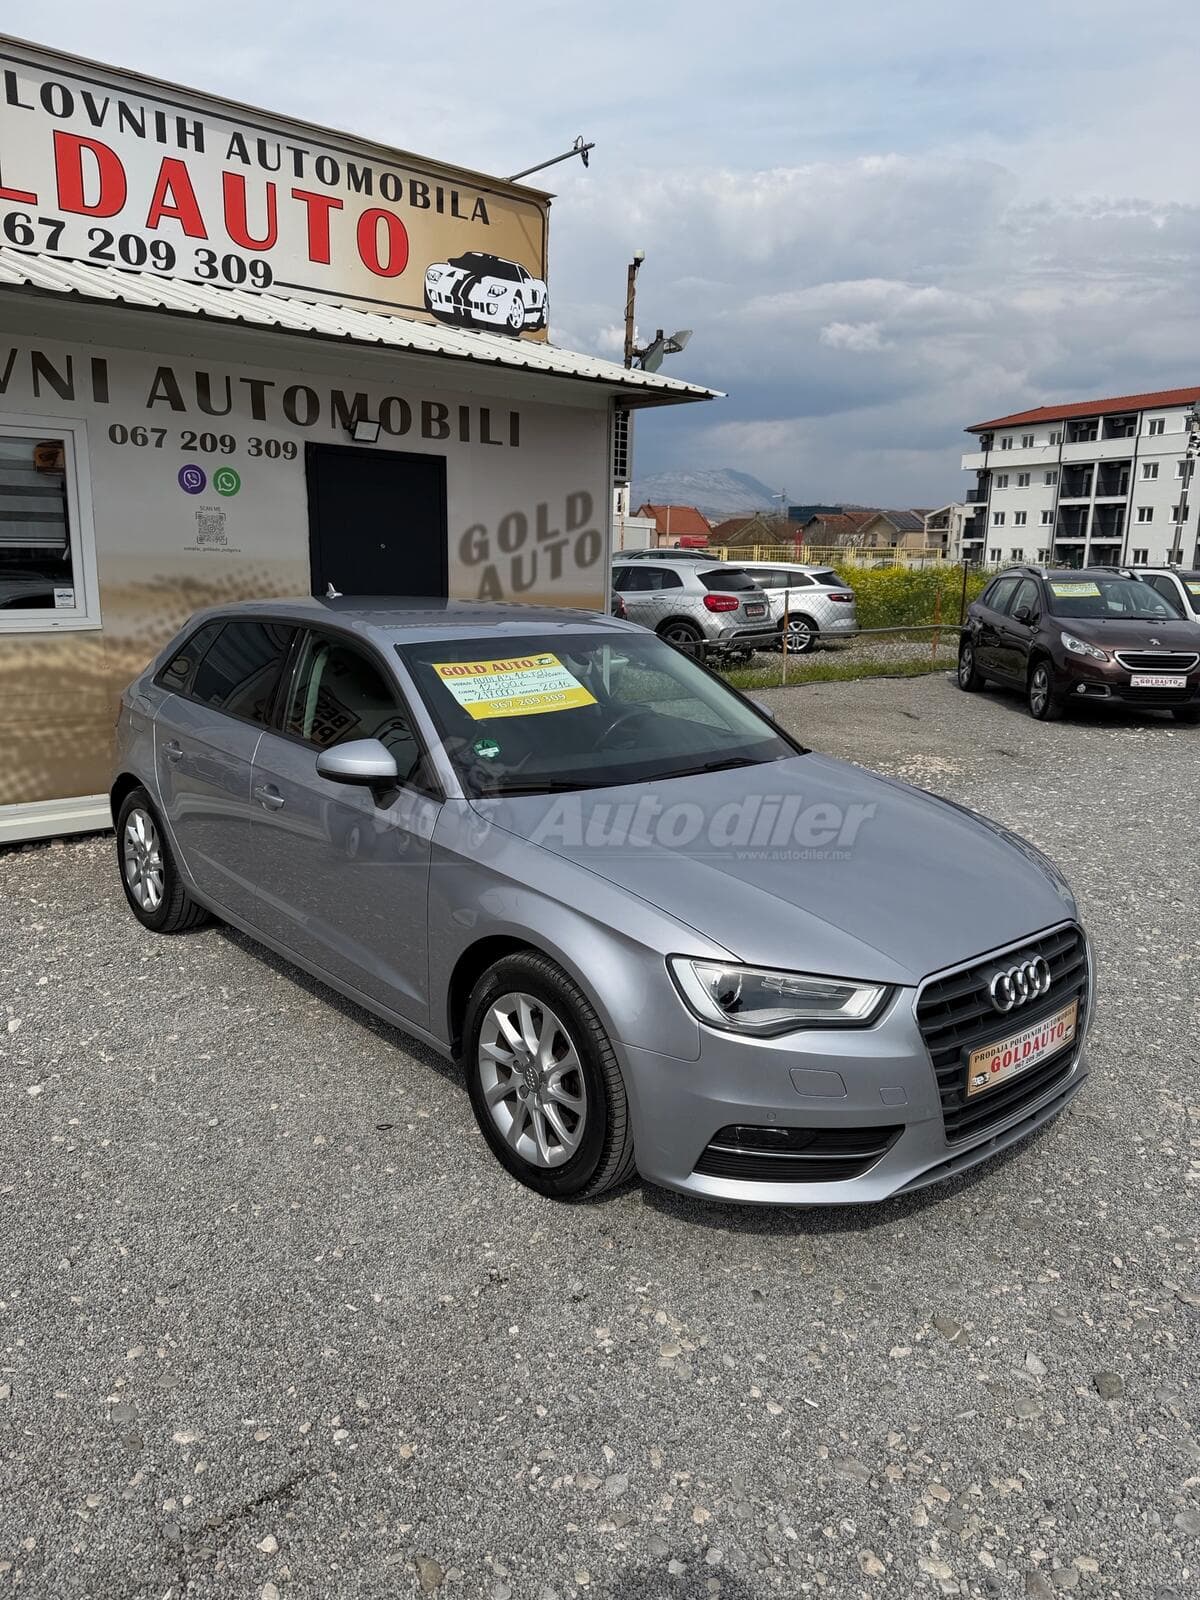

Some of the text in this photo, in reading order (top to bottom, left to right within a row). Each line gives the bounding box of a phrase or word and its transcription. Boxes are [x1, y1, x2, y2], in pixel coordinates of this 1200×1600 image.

[225, 131, 490, 226] AUTOMOBILA
[3, 211, 274, 289] 67 209 309
[108, 423, 299, 461] 067 209 309
[146, 366, 521, 448] AUTOMOBILI
[459, 490, 594, 567] GOLD
[477, 528, 603, 601] AUTO
[440, 659, 533, 677] GOLD AUTO
[974, 1044, 1008, 1063] PRODAJA
[1009, 1027, 1042, 1048] POLOVNIH
[990, 1021, 1064, 1073] GOLDAUTO
